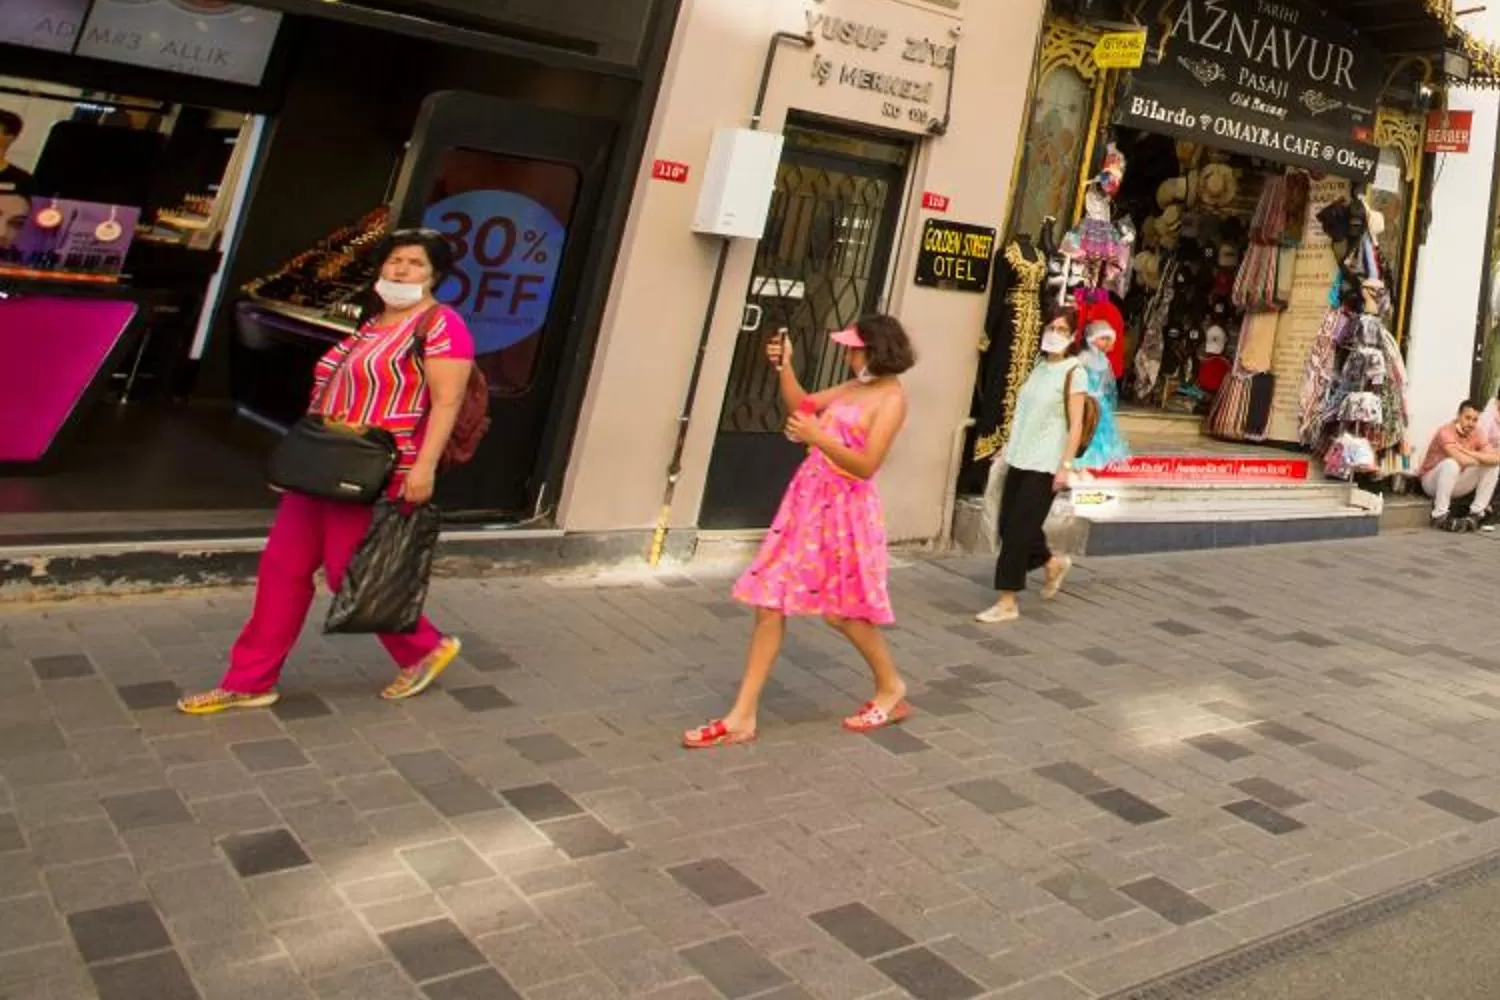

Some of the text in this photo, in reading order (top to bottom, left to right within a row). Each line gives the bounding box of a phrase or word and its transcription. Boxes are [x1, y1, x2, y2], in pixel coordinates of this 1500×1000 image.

[805, 10, 888, 51] YUSUF
[1171, 0, 1356, 91] AZNAVUR
[1238, 67, 1289, 99] PASAJI
[1131, 96, 1375, 175] Bilardo OMAYRA CAFE Okey
[924, 227, 962, 255] GOLDEN
[933, 256, 977, 281] OTEL
